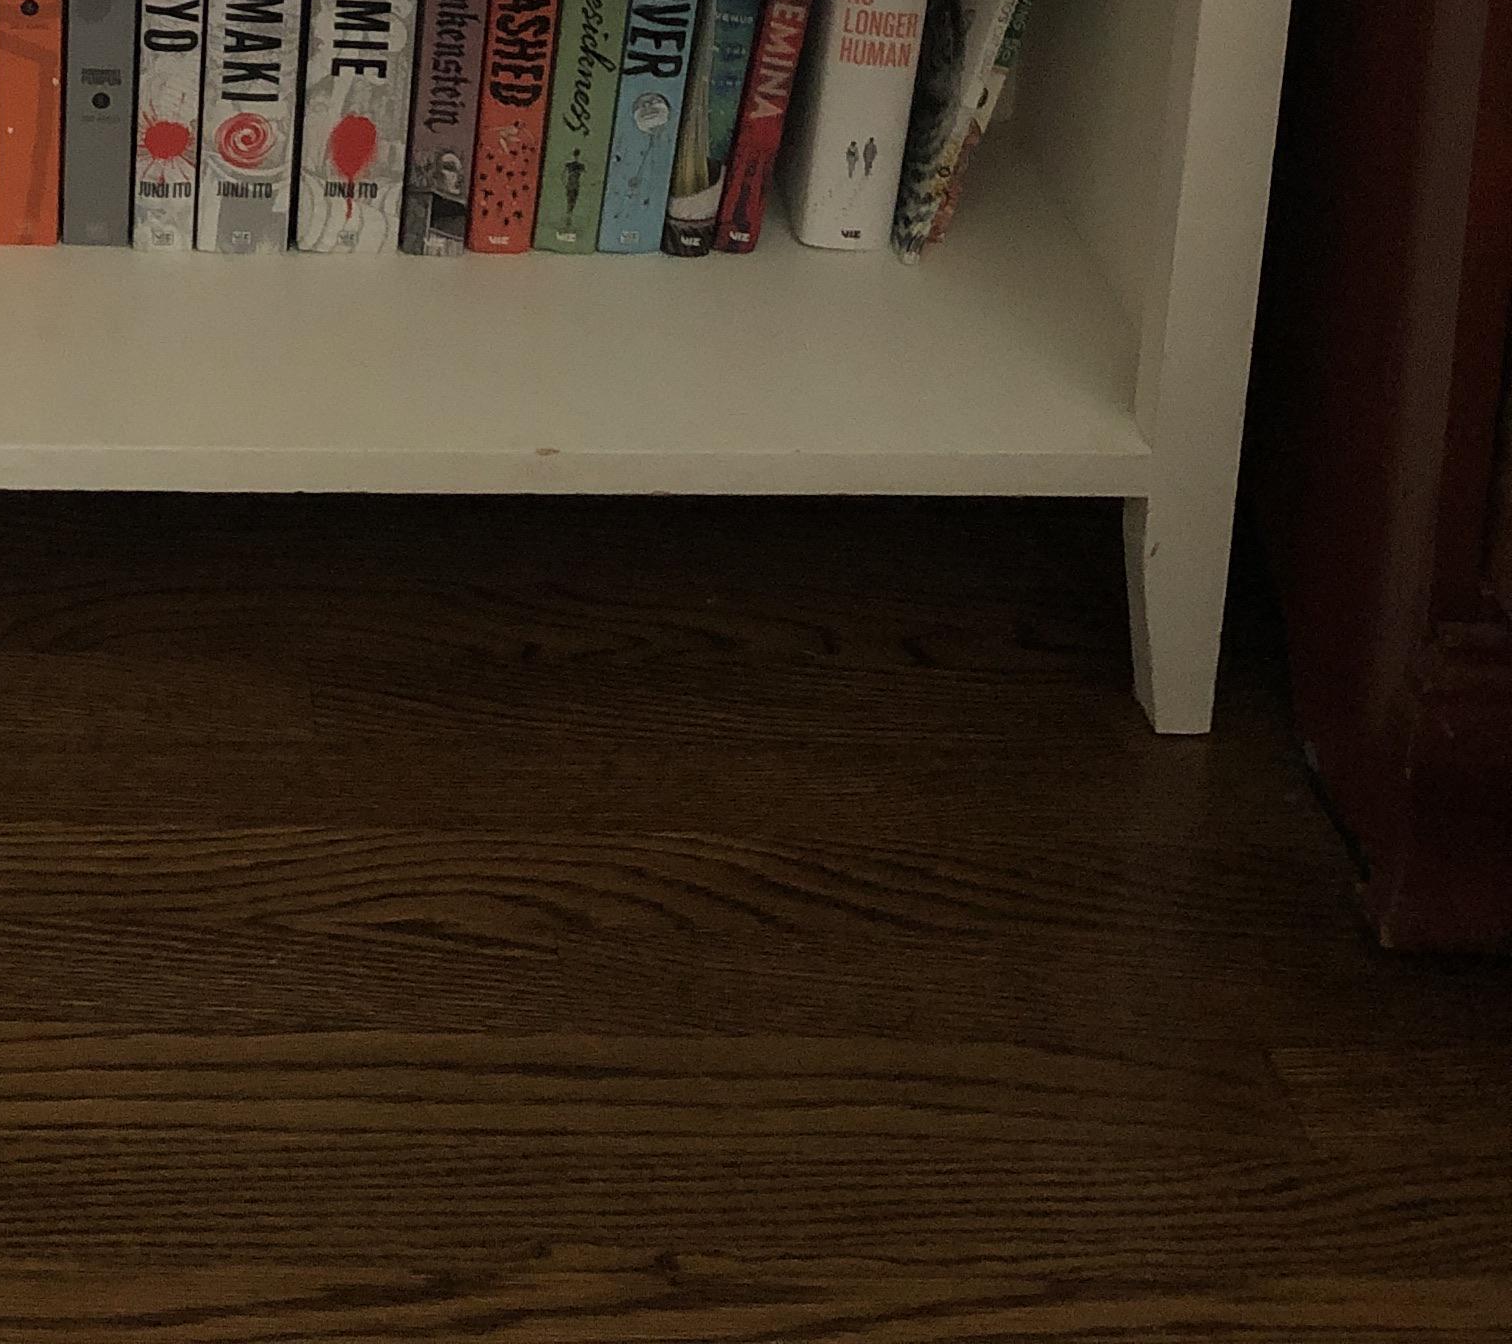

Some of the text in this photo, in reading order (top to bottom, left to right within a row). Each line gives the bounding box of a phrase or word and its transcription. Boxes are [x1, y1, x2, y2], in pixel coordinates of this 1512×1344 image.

[844, 8, 918, 38] LONGER
[840, 36, 911, 67] HUMAN
[139, 181, 192, 198] JUNJI ITO
[217, 181, 272, 198] JUNJI ITO
[841, 230, 861, 239] VIZ
